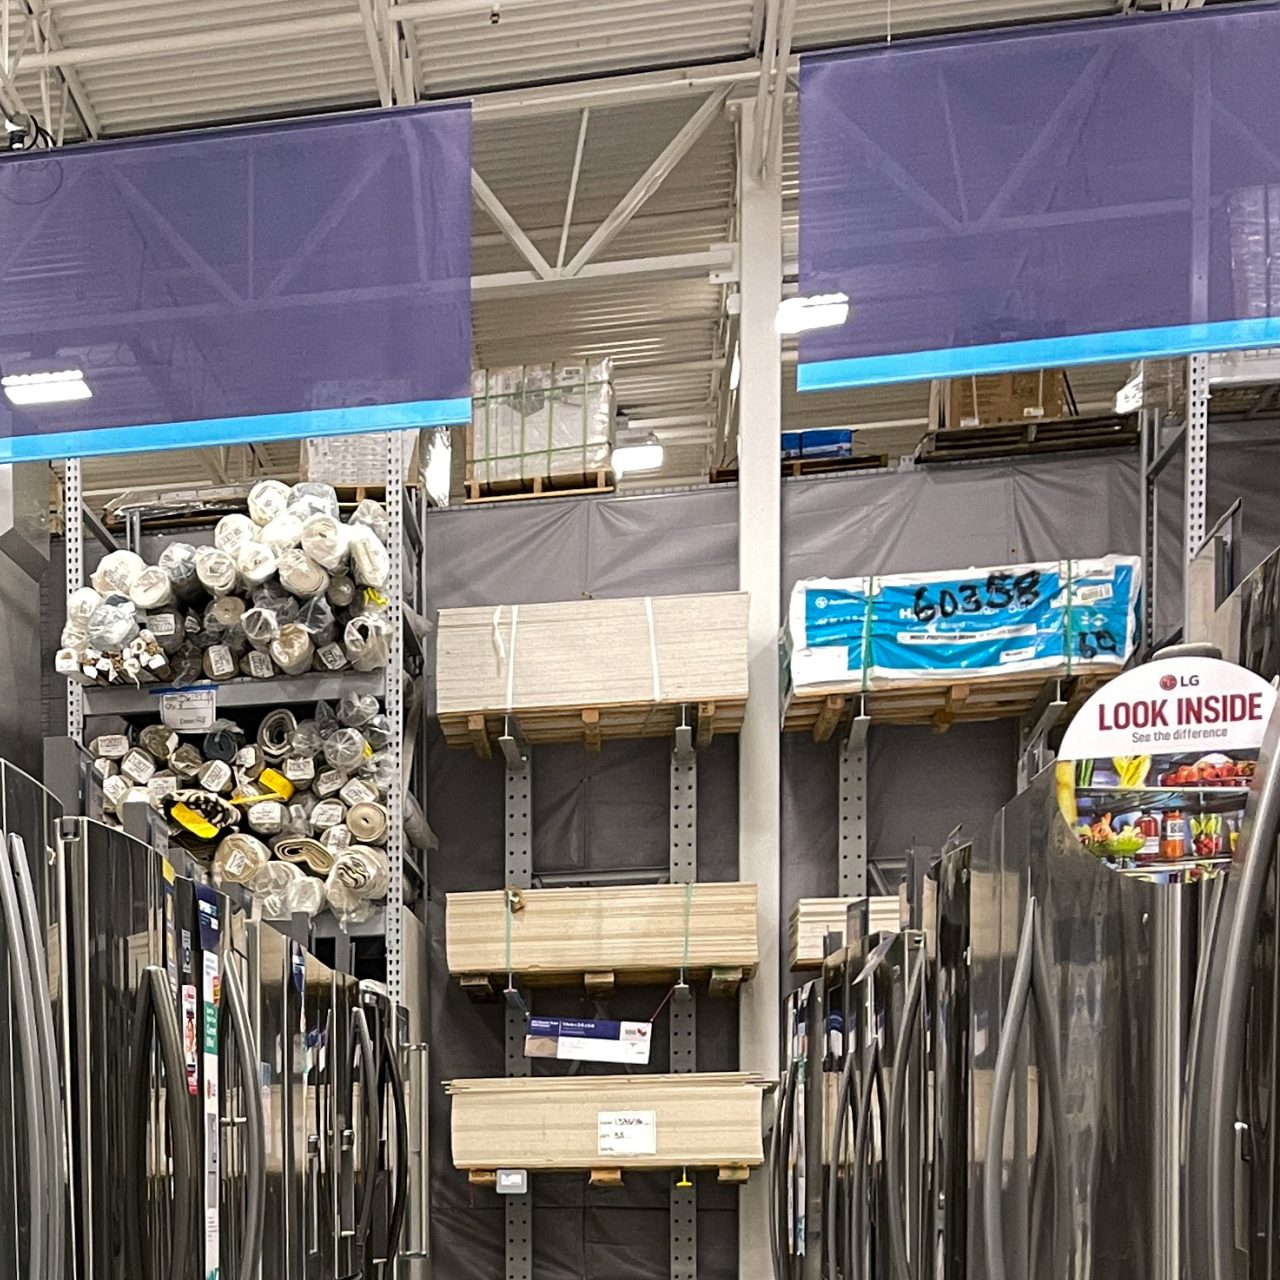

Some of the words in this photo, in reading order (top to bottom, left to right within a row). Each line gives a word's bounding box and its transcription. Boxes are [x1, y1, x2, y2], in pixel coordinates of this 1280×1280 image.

[1180, 675, 1200, 687] LG
[1098, 699, 1169, 731] LOOK
[1177, 692, 1263, 725] INSIDE
[1131, 731, 1151, 743] See
[1153, 730, 1171, 741] the
[1173, 727, 1228, 740] difference
